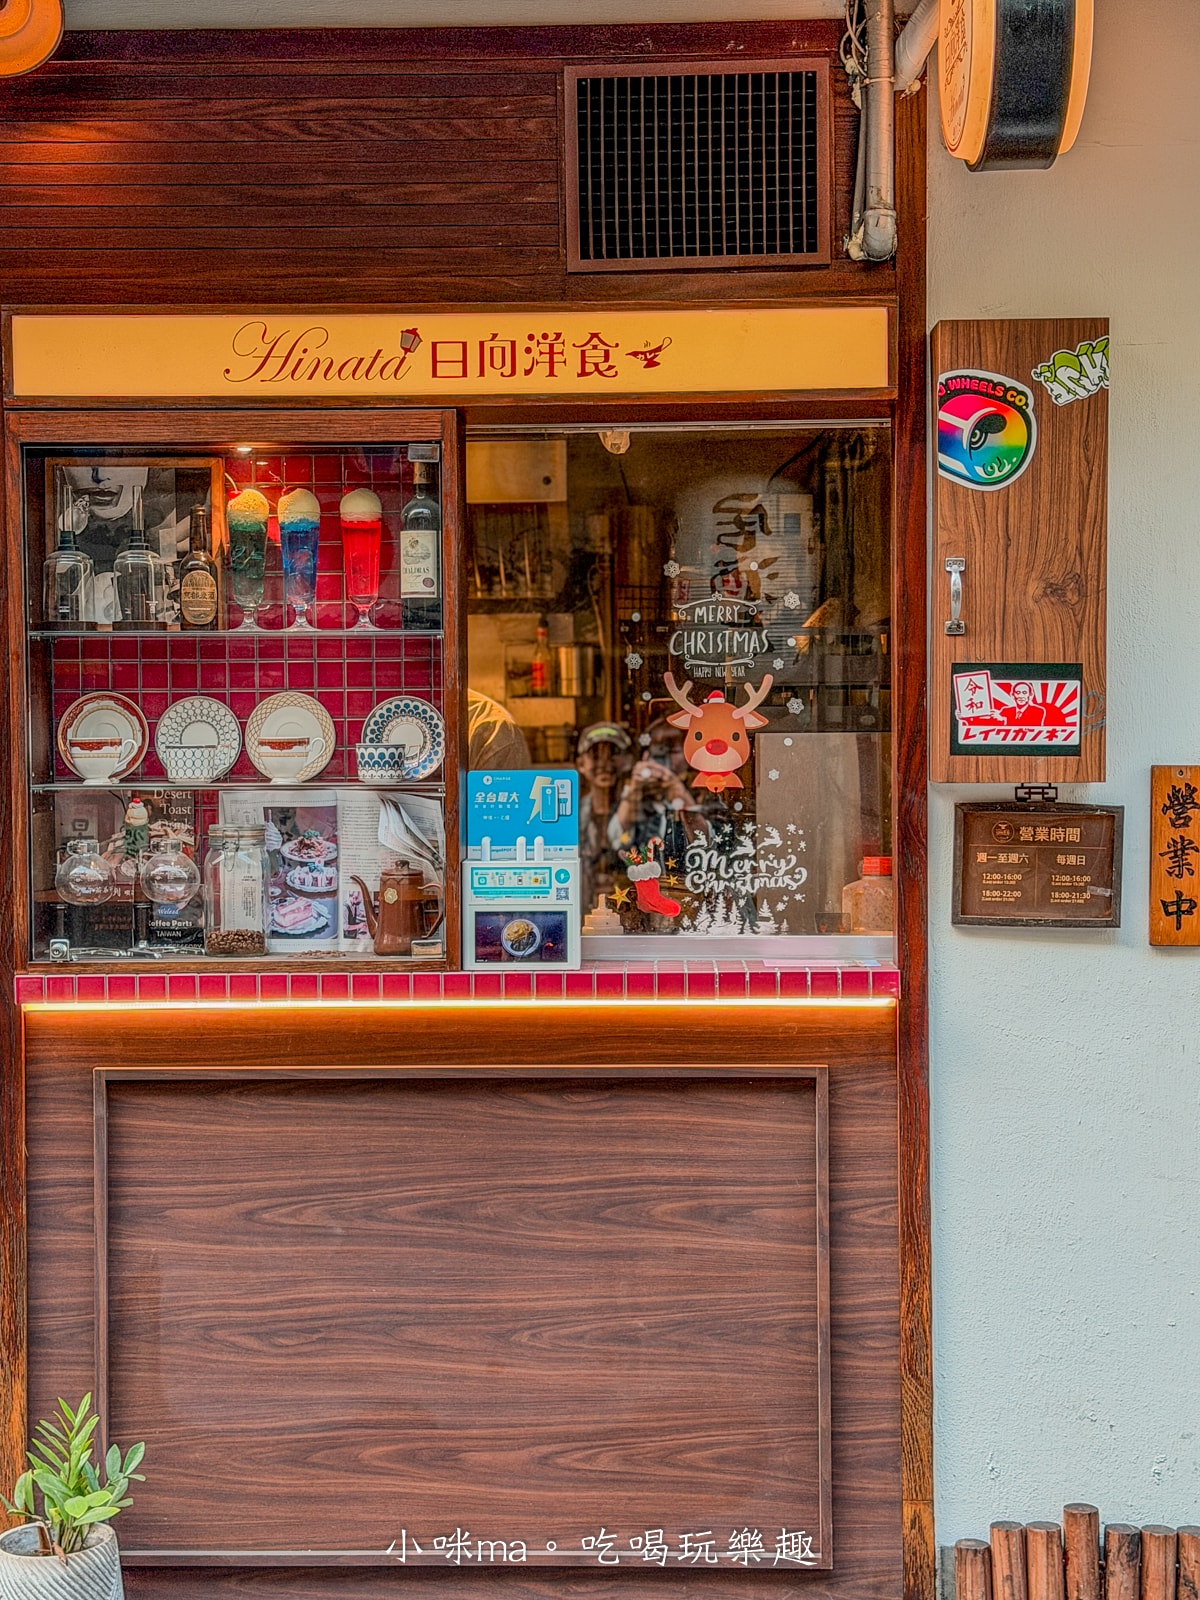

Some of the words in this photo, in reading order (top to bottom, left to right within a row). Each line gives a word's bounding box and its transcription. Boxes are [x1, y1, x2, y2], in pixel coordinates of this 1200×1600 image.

[223, 321, 412, 383] Hinata
[431, 331, 620, 379] 日向洋食
[947, 377, 1005, 397] WHEELS
[1006, 390, 1027, 410] CO.
[694, 605, 741, 624] MERRY
[669, 629, 769, 656] CHRISTMAS
[693, 665, 712, 678] HAPPY
[964, 677, 985, 714] 令和
[962, 727, 1076, 742] レイワガンネン
[153, 788, 193, 800] Desert
[159, 803, 192, 815] Toast
[1019, 826, 1081, 842] 營業時間
[685, 848, 797, 878] Merry
[976, 852, 1029, 864] 週一至週六
[1056, 854, 1086, 866] 每週日
[1158, 782, 1200, 931] 營業中
[685, 866, 808, 897] Christmas
[1051, 874, 1091, 882] 12:00-16:00
